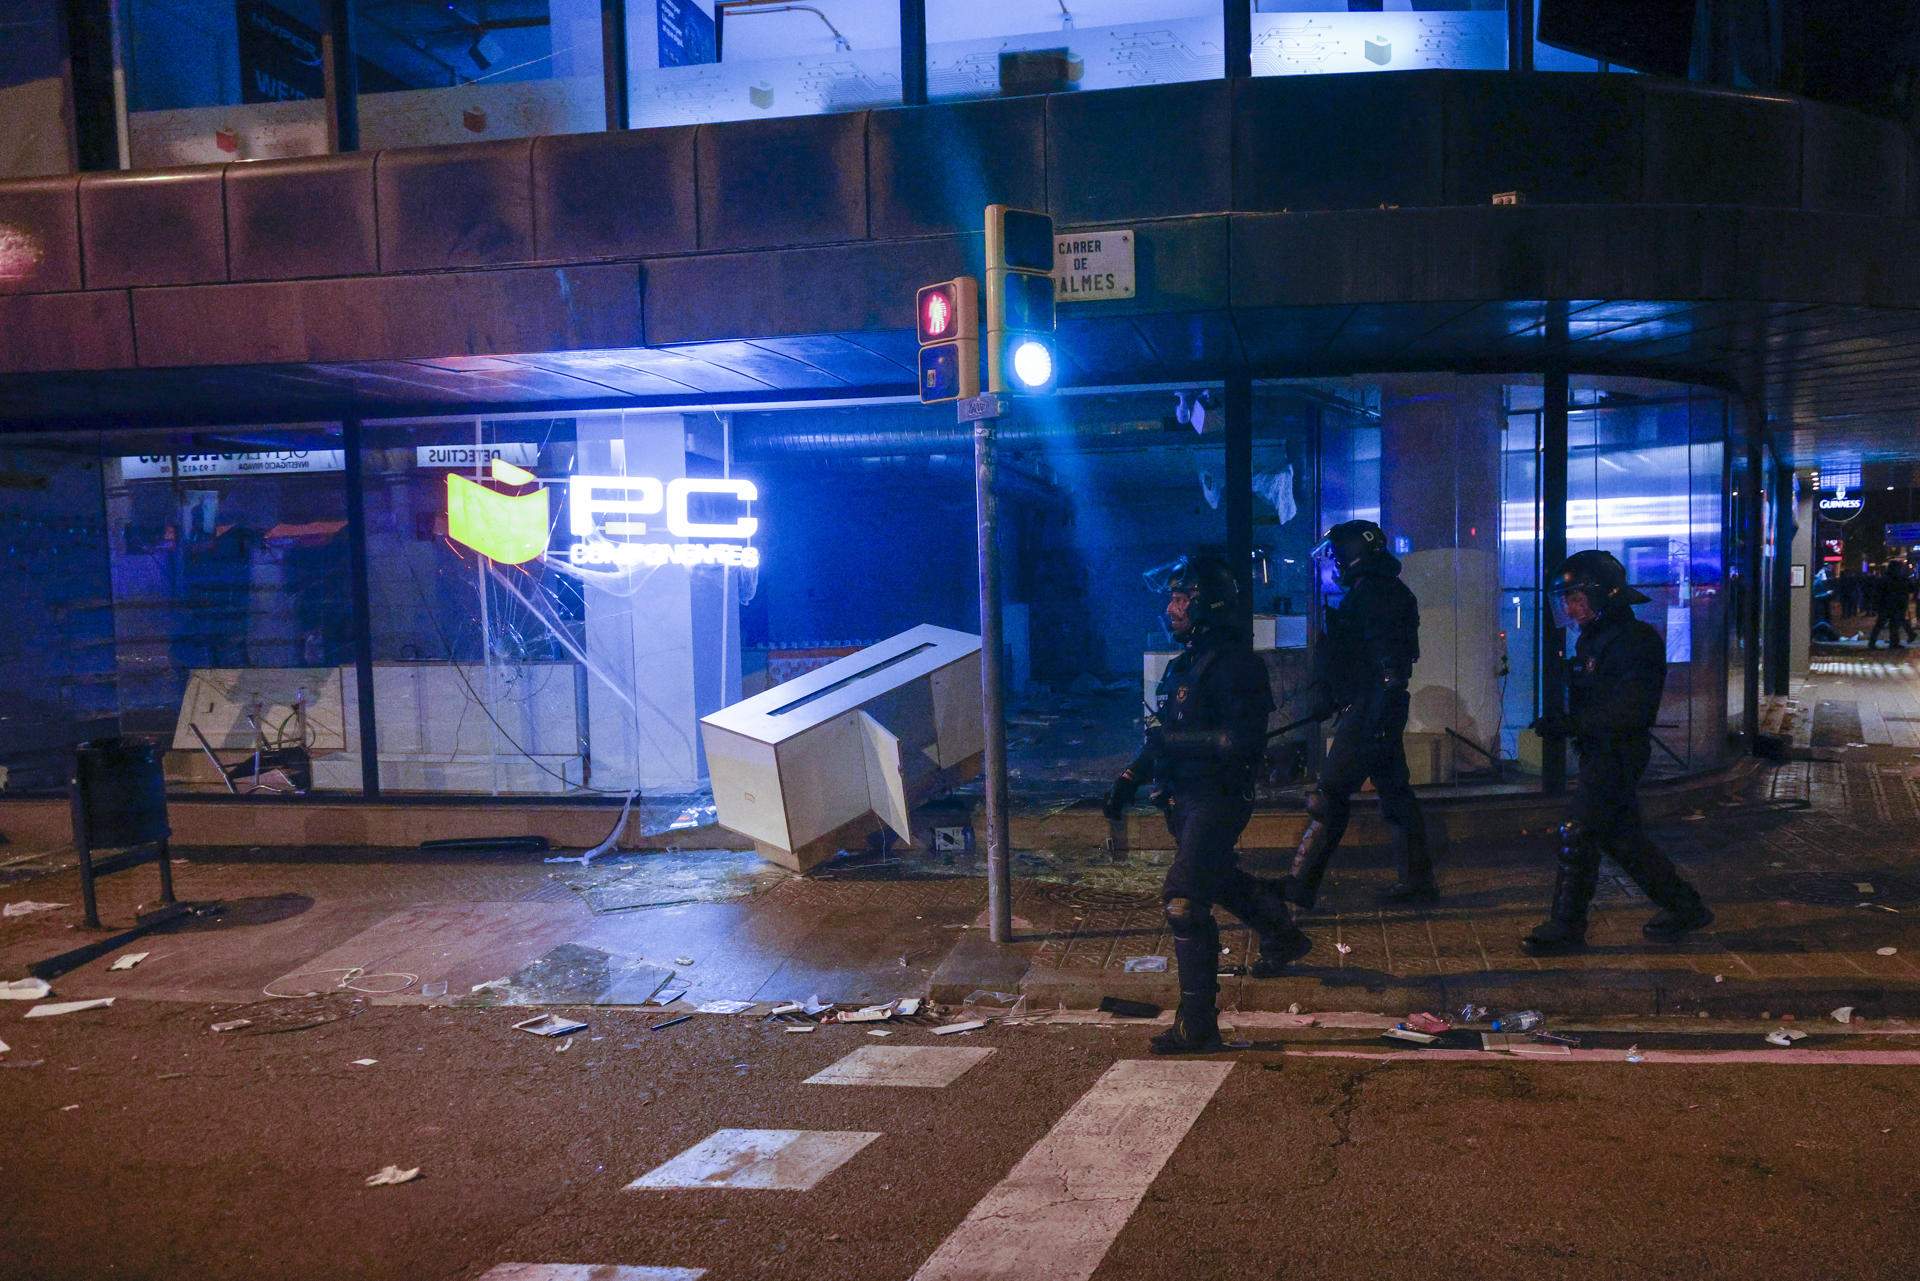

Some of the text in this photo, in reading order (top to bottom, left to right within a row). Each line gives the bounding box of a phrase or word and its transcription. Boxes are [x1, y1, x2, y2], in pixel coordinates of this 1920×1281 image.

[1058, 239, 1102, 254] CARRER
[1073, 257, 1088, 270] DE
[1053, 273, 1115, 293] ALMES
[570, 475, 758, 538] PC
[1819, 499, 1861, 509] GUINNESS
